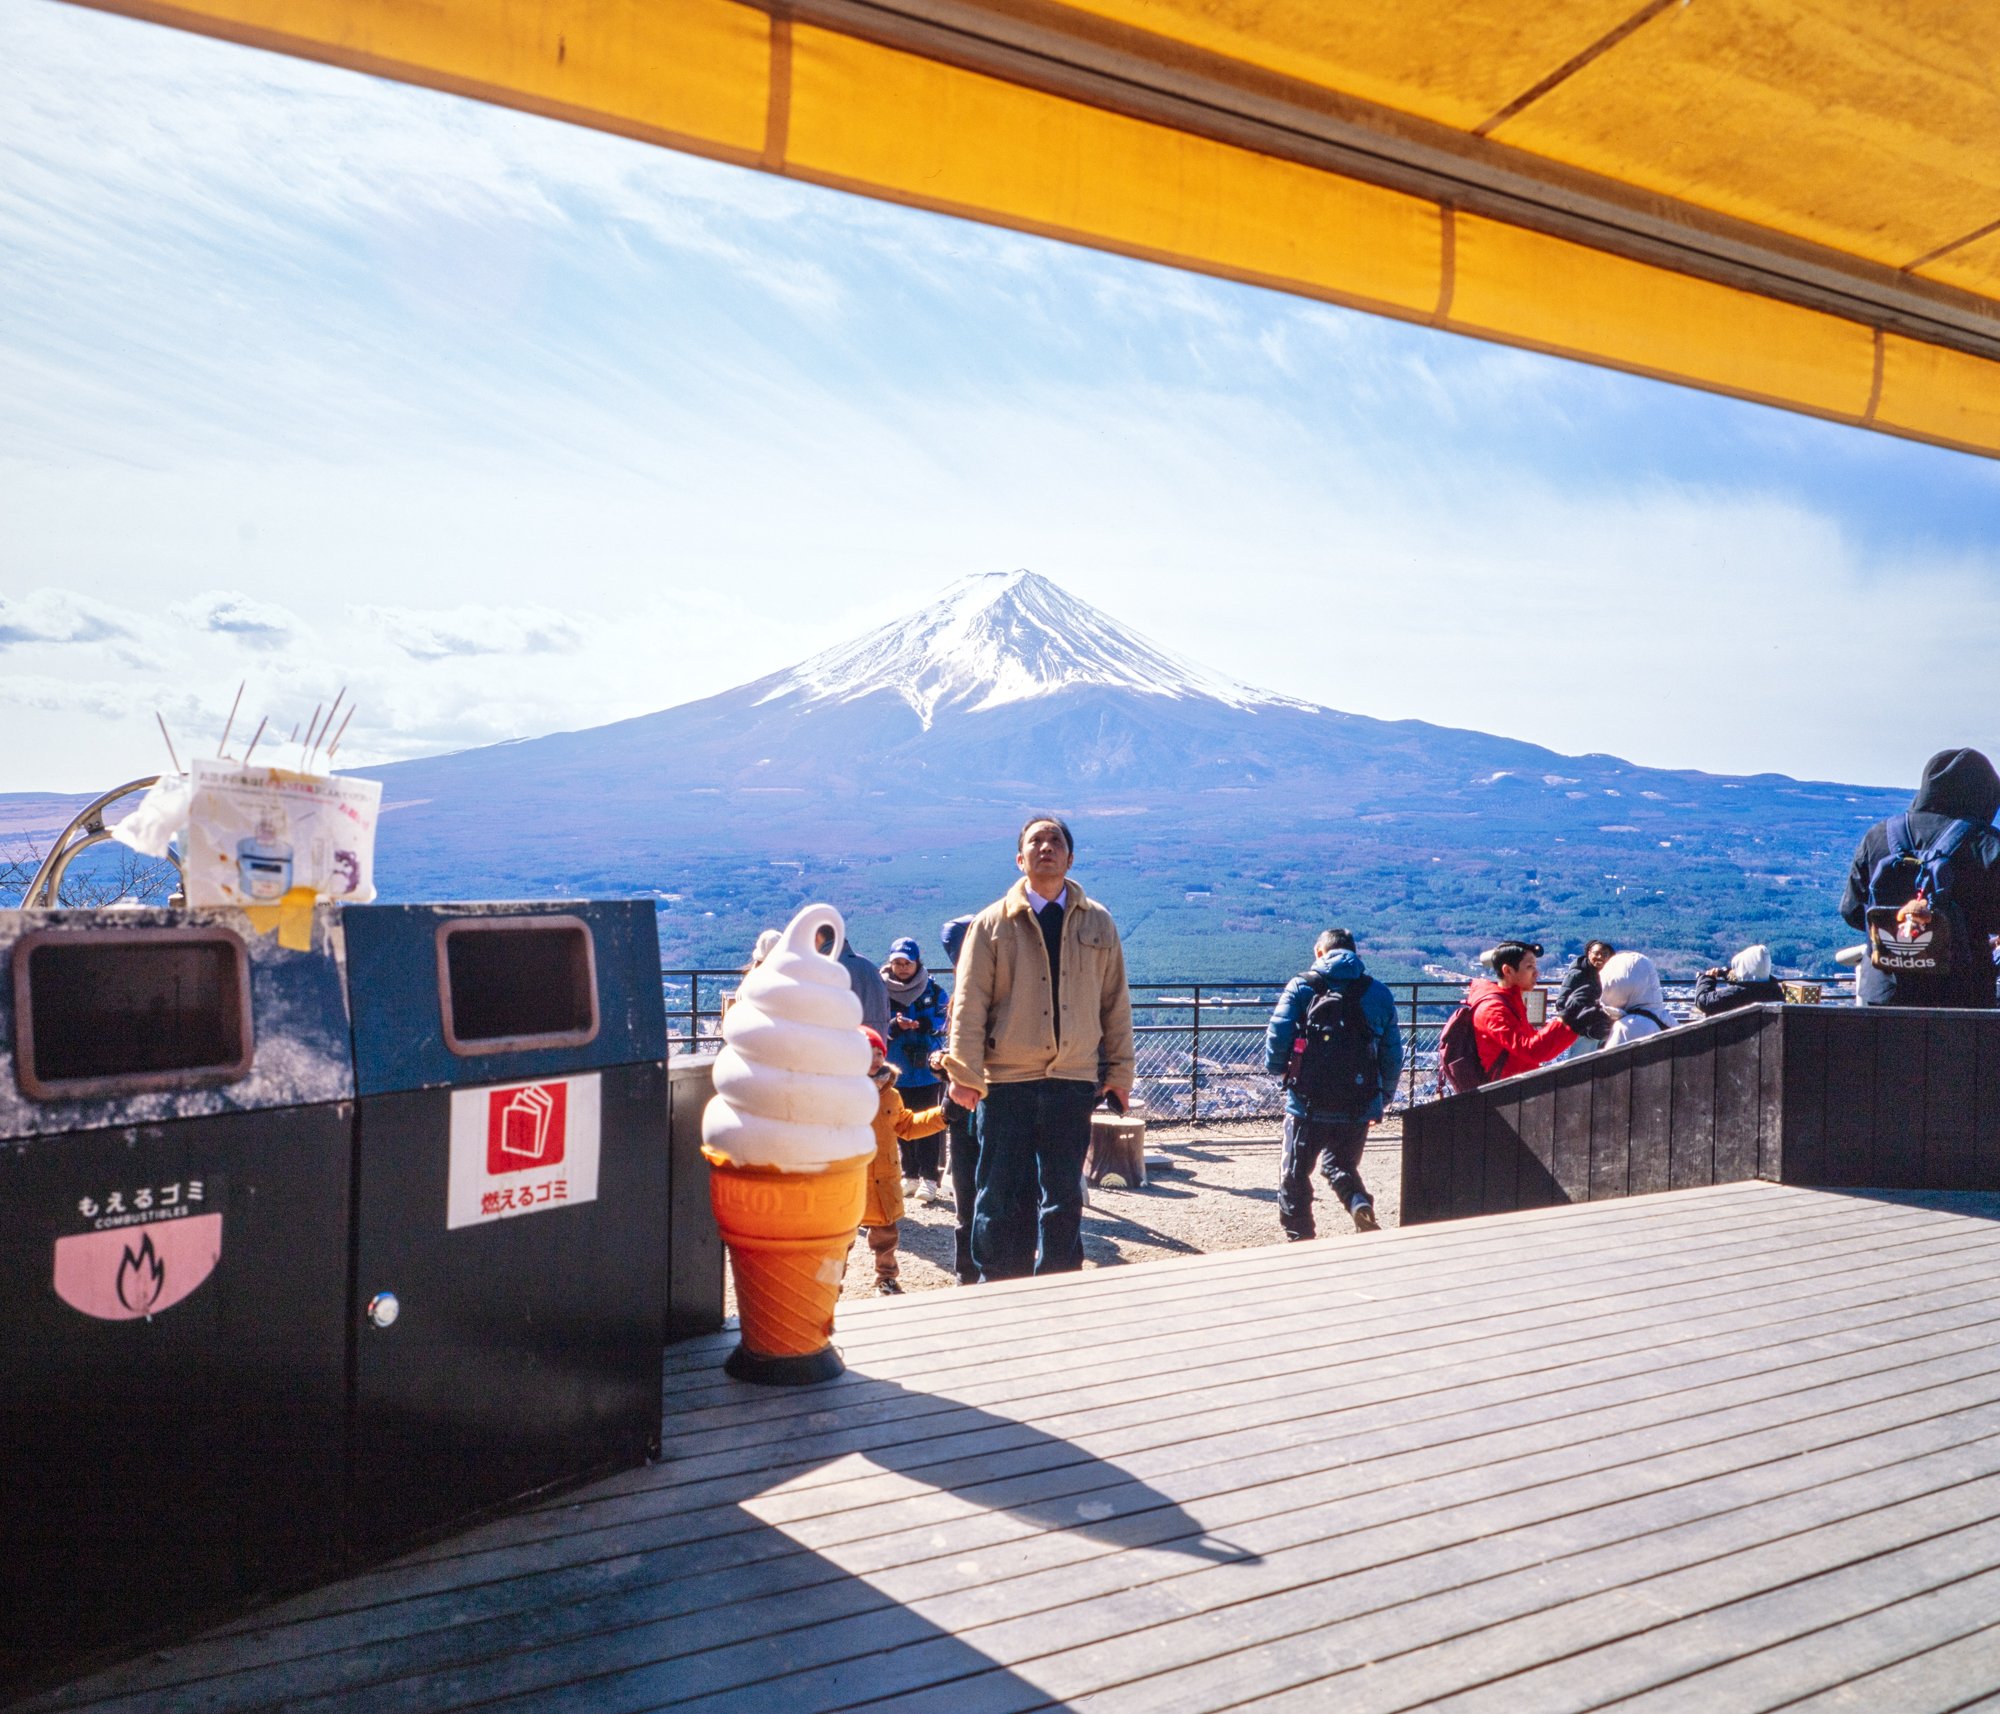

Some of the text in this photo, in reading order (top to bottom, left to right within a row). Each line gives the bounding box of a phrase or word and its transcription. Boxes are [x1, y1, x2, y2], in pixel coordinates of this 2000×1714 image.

[1880, 956, 1936, 968] adidas
[78, 1181, 203, 1217] もえるゴミ
[481, 1180, 567, 1215] 燃えるゴミ
[95, 1205, 189, 1229] COMBUSTIBLES
